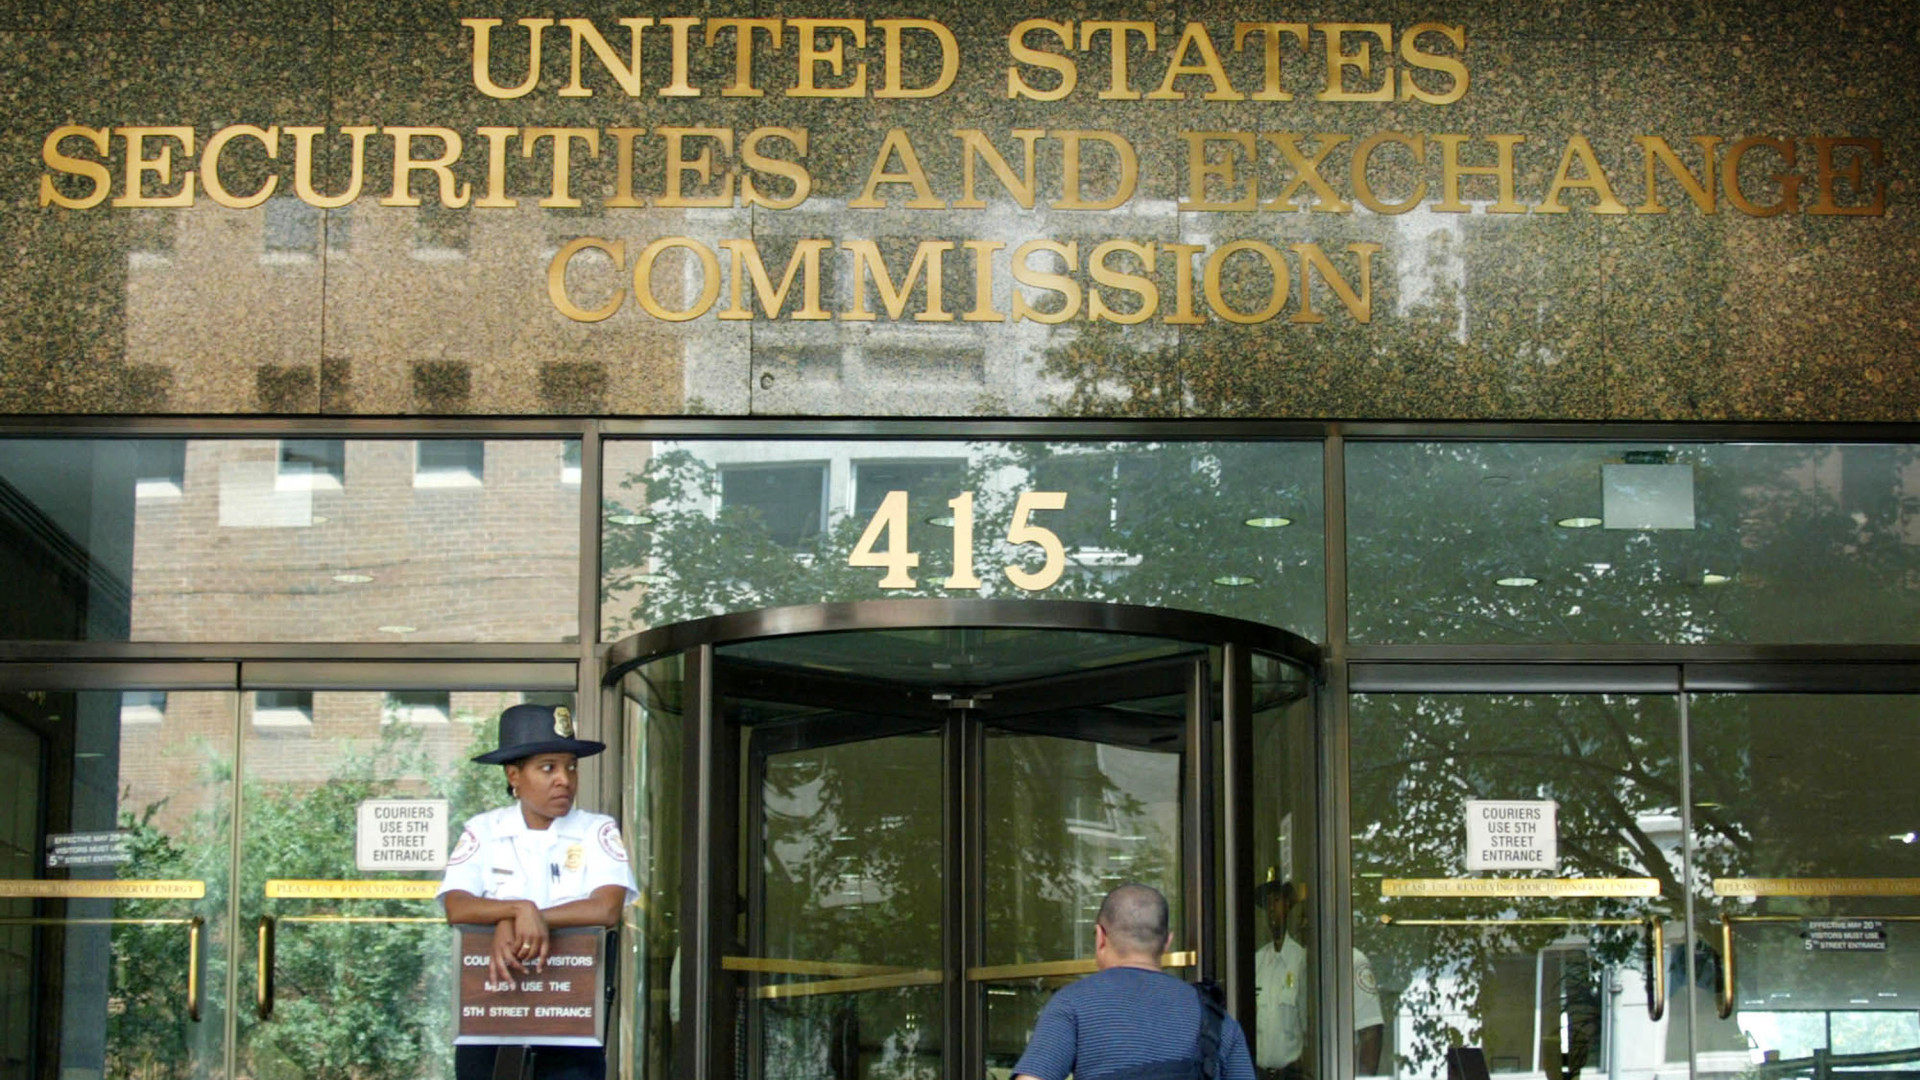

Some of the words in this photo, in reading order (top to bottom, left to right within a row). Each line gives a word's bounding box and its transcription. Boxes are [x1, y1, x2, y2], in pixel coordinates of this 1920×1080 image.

[462, 16, 961, 102] UNITED
[1007, 18, 1470, 105] STATES
[37, 122, 815, 211] SECURITIES
[849, 127, 1141, 211] AND
[1177, 130, 1885, 219] EXCHANGE
[547, 236, 1381, 326] COMMISSION
[848, 491, 1067, 590] 415
[374, 807, 434, 819] COURIERS
[1482, 807, 1541, 820] COURIERS
[380, 821, 402, 833] USE
[406, 821, 429, 833] 5TH
[1488, 822, 1511, 833] USE
[1514, 822, 1536, 833] 5TH
[382, 835, 426, 847] STREET
[1491, 836, 1534, 847] STREET
[55, 846, 88, 854] VISITORS
[373, 849, 435, 861] ENTRANCE
[1482, 850, 1543, 861] ENTRANCE
[65, 855, 92, 864] STREET
[155, 885, 194, 893] ENERGY
[1456, 883, 1514, 892] REVOLVING
[1809, 921, 1846, 929] EFFECTIVE
[1810, 931, 1842, 939] VISITORS
[1844, 931, 1863, 939] MUST
[1864, 931, 1880, 939] USE
[1820, 941, 1846, 949] STREET
[1847, 941, 1886, 949] ENTRANCE
[547, 955, 594, 966] VISITORS
[521, 981, 544, 992] USE
[548, 981, 572, 992] THE
[463, 1006, 484, 1018] 5TH
[489, 1006, 530, 1018] STREET
[534, 1006, 592, 1018] ENTRANCE
